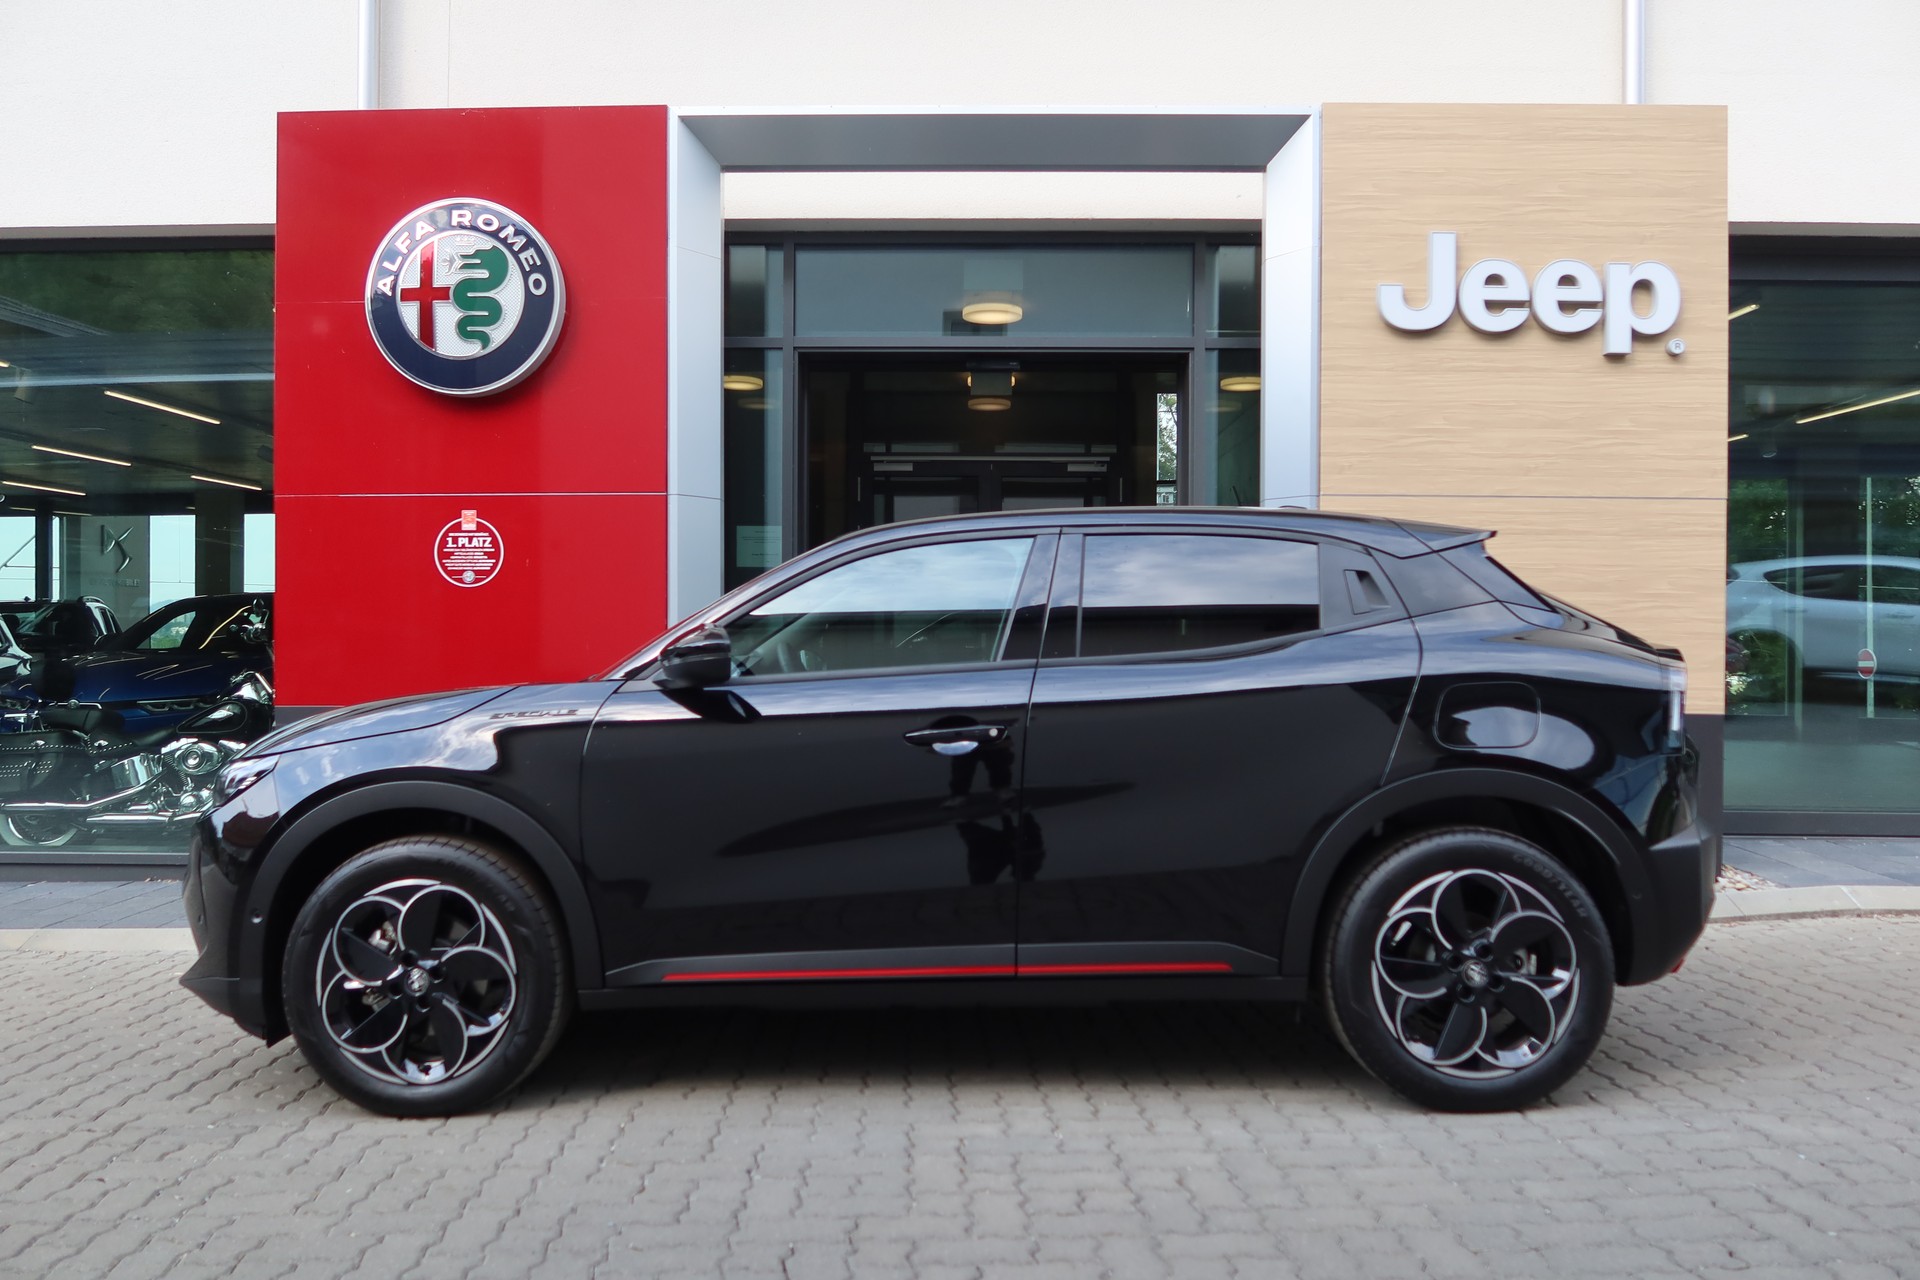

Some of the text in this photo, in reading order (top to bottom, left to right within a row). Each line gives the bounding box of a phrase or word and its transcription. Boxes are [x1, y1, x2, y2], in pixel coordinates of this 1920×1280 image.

[376, 209, 547, 297] ALFA ROMEO
[1377, 231, 1681, 356] Jeep
[458, 537, 493, 548] PLATZ
